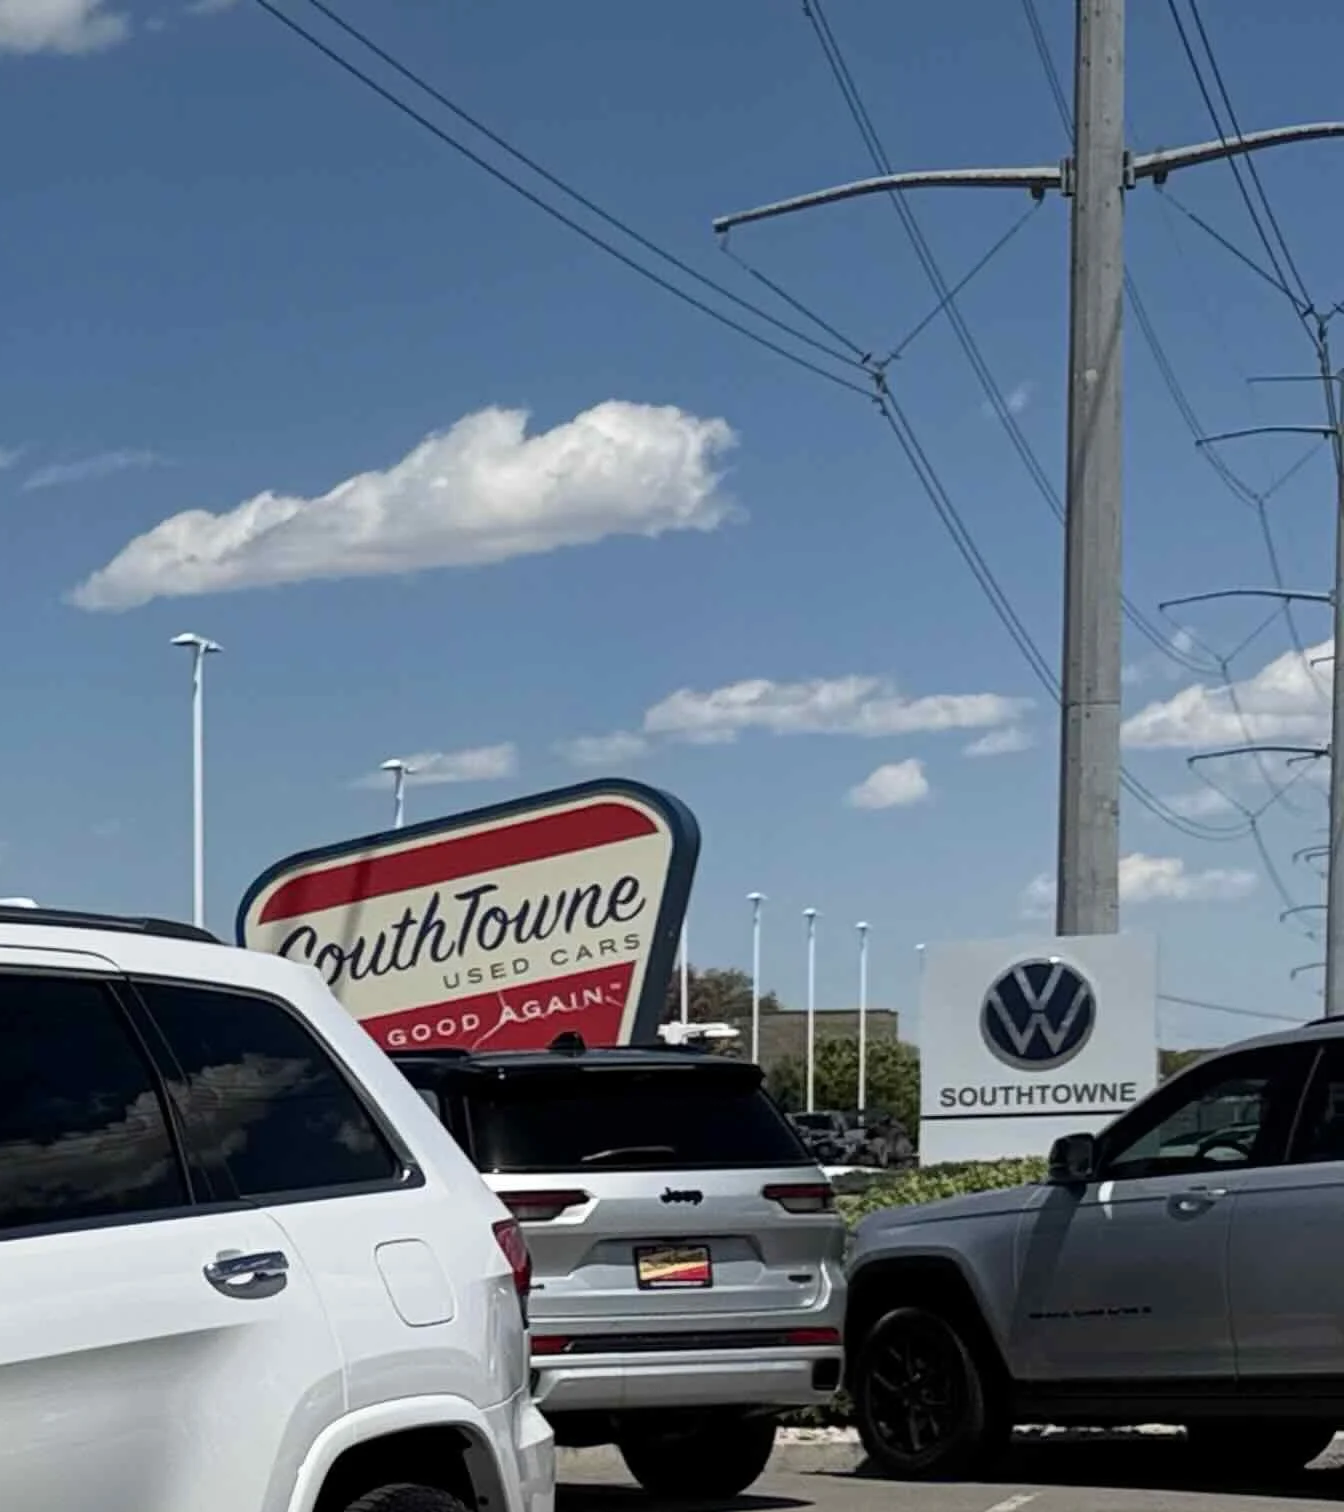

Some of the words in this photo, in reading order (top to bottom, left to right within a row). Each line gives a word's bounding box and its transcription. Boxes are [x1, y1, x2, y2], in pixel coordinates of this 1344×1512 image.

[443, 957, 530, 990] USED
[550, 933, 641, 966] CARS
[387, 1013, 480, 1046] GOOD
[939, 1082, 1137, 1108] SOUTHTOWNE
